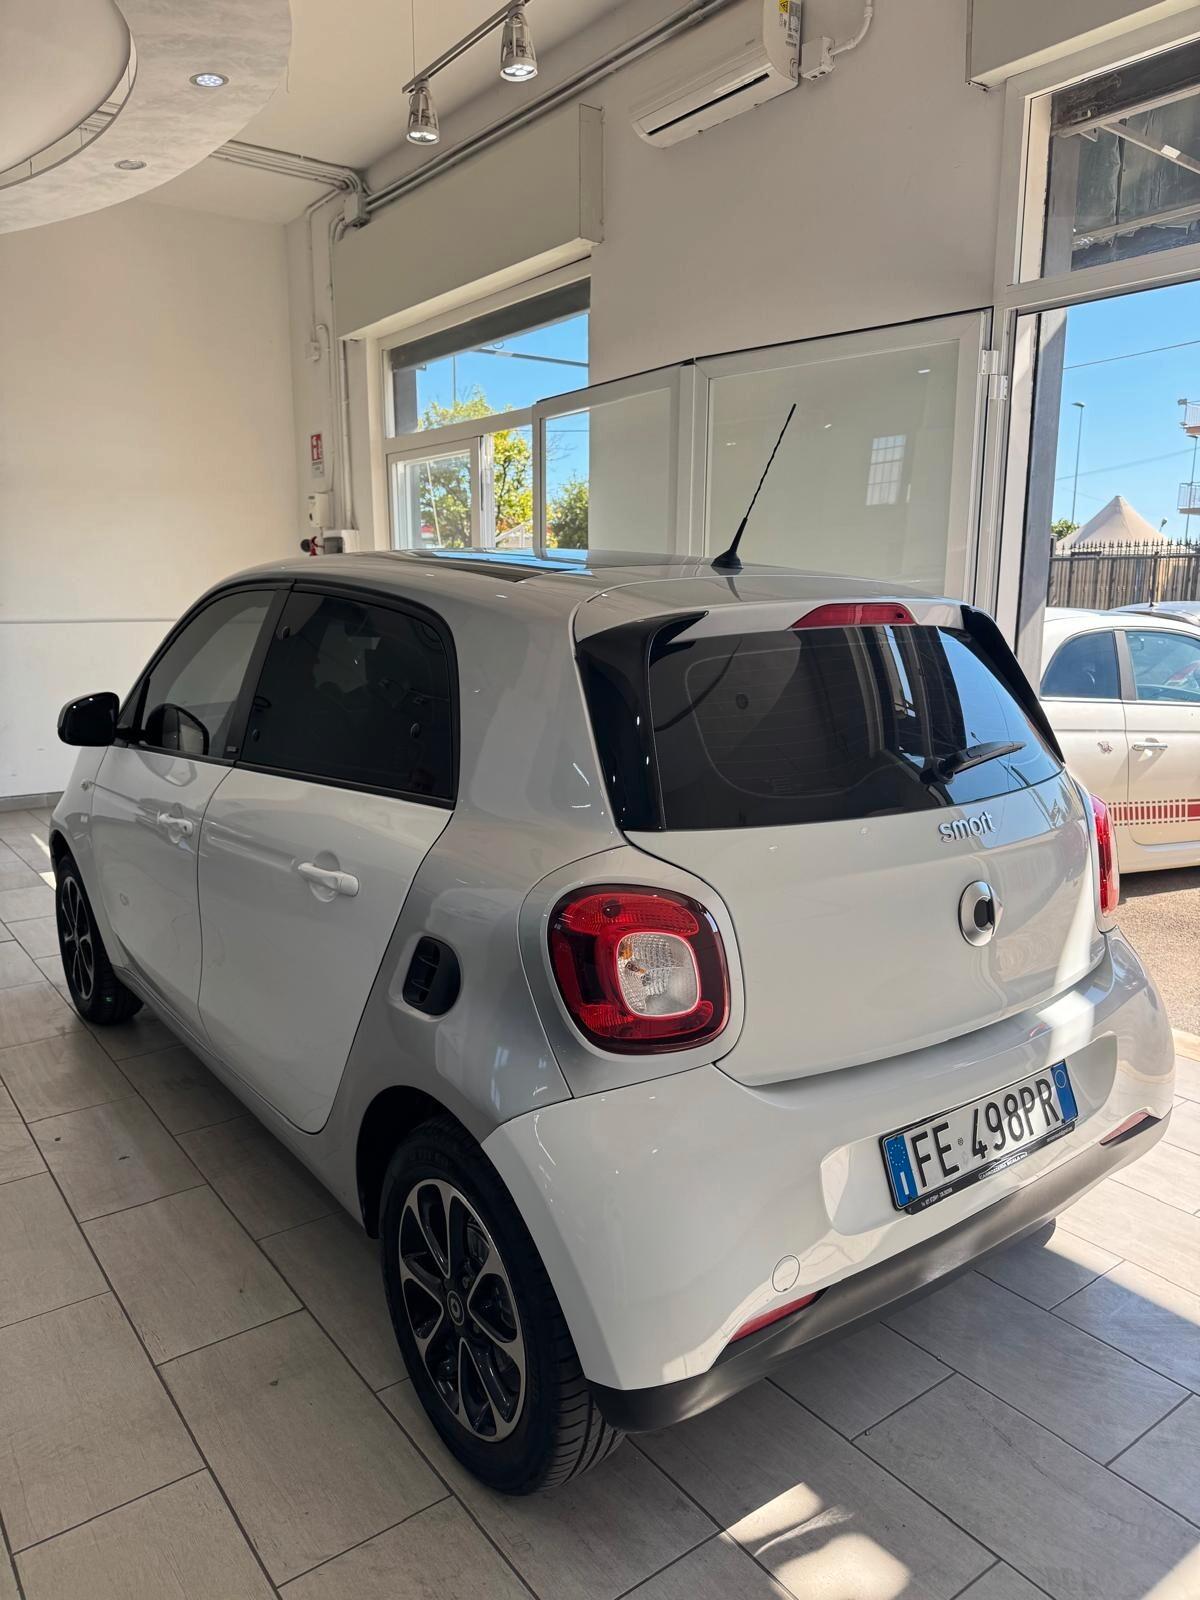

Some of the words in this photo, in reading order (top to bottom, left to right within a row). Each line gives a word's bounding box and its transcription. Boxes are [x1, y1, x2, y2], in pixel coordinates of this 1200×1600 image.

[938, 811, 996, 843] smart
[911, 1121, 960, 1188] FE
[971, 1078, 1061, 1160] 498PR
